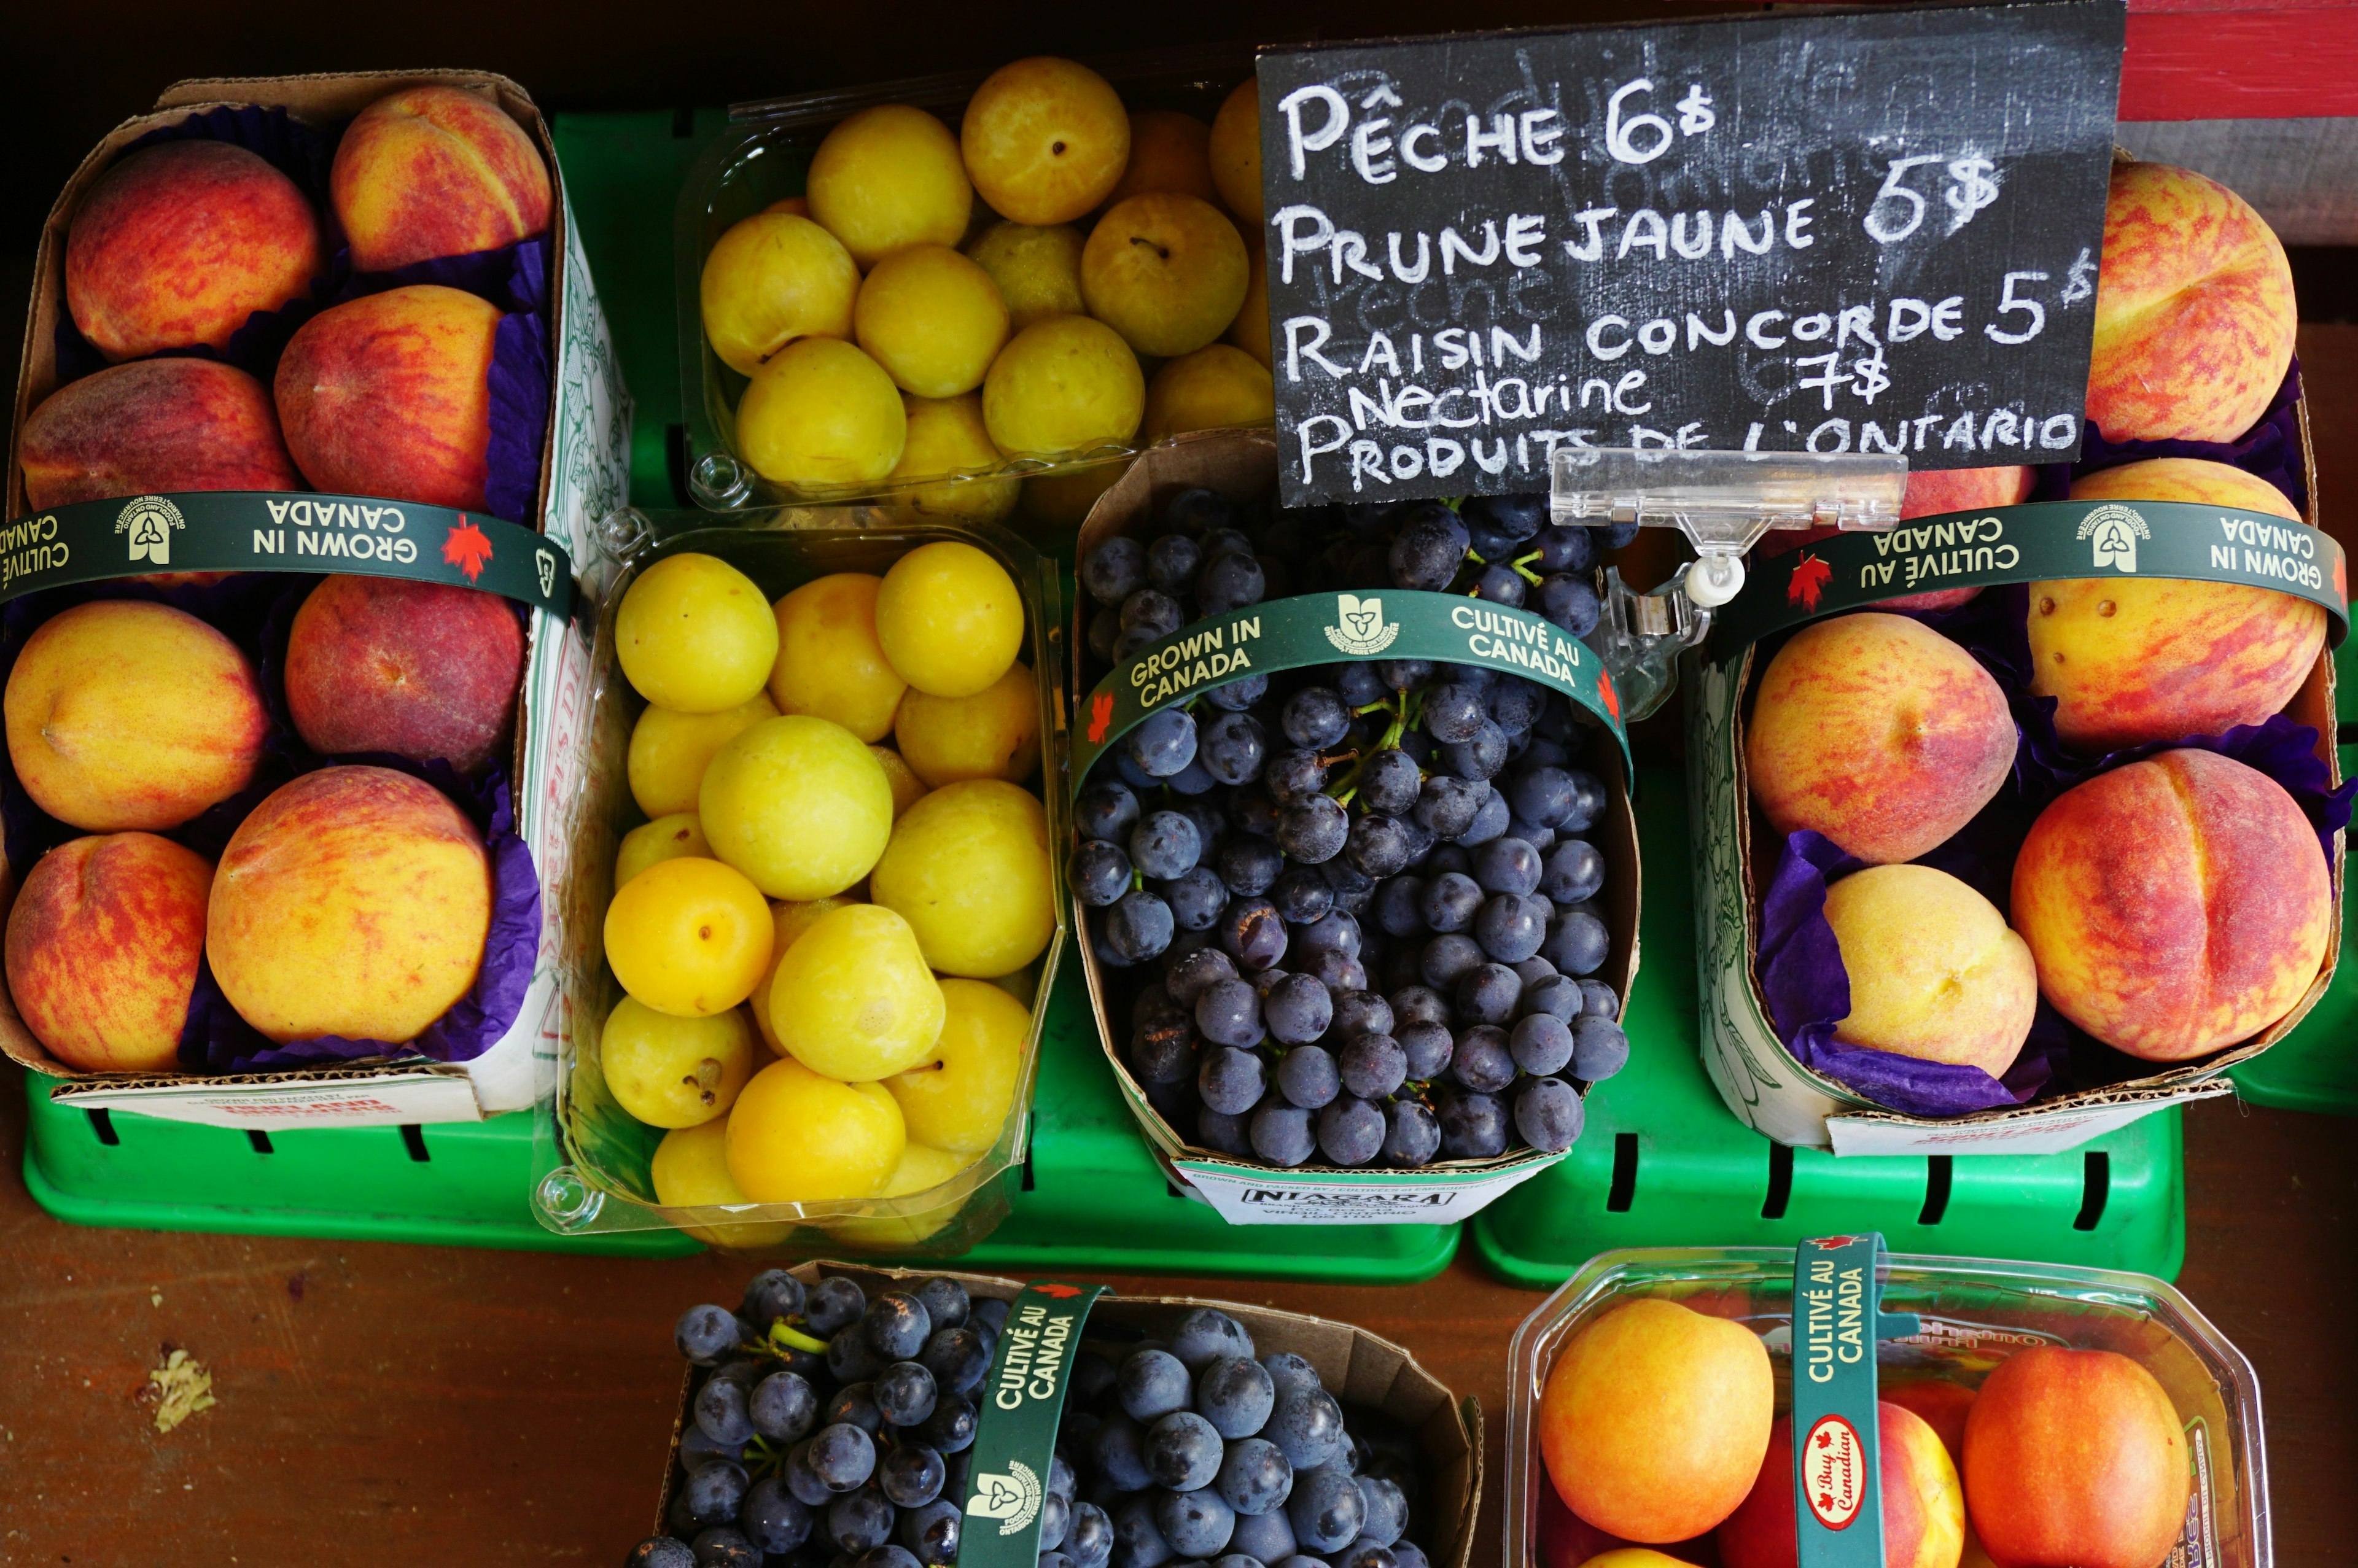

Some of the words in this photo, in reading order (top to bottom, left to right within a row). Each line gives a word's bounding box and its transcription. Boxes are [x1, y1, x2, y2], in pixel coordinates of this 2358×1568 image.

[1277, 84, 1564, 184] PÊCHE
[1606, 78, 1716, 164] 6$
[1272, 204, 1546, 284] PRUNE
[1563, 199, 1815, 260] JAUNE
[1864, 151, 1999, 244] 5$
[1283, 316, 1541, 381] RAISIN
[1586, 297, 1964, 361] CONCORDE
[1348, 369, 1652, 429] Nectarine
[1797, 347, 1890, 409] 7$
[1298, 415, 1600, 492] PRODUITS
[1628, 422, 1708, 461] DE
[123, 505, 146, 529] ONTARIO
[145, 504, 176, 526] FOODLAND
[266, 500, 405, 533] CANADA
[2086, 514, 2111, 536] ONTARIO
[2111, 513, 2141, 536] FOODLAND
[254, 530, 284, 553] IN
[297, 531, 418, 564] GROWN
[1873, 517, 2003, 556] CANADA
[2220, 517, 2314, 559] CANADA
[3, 542, 69, 590] CULTIVÉ
[1861, 560, 1896, 588] AU
[1905, 545, 2020, 589] CULTIVÉ
[2211, 545, 2236, 570] IN
[2245, 551, 2322, 589] GROWN
[1131, 627, 1223, 687] GROWN
[1232, 616, 1261, 643] IN
[1334, 628, 1367, 648] FOODLAND
[1366, 626, 1390, 646] ONTARIO
[1452, 607, 1548, 649] CULTIVÉ
[1554, 637, 1579, 667] AU
[1140, 648, 1251, 708] CANADA
[1468, 634, 1576, 687] CANADA
[1248, 1189, 1441, 1205] NIAGARA
[1811, 1260, 1835, 1284] AU
[1838, 1268, 1863, 1363] CANADA
[1802, 1291, 1834, 1383] CULTIVÉ
[996, 1328, 1038, 1410] CULTIVÉ
[1020, 1306, 1046, 1327] AU
[1029, 1316, 1073, 1400] CANADA
[1011, 1471, 1032, 1496] ONTARIO
[1817, 1453, 1836, 1490] Buy
[1836, 1430, 1853, 1511] Canadian
[1005, 1496, 1032, 1525] FOODLAND
